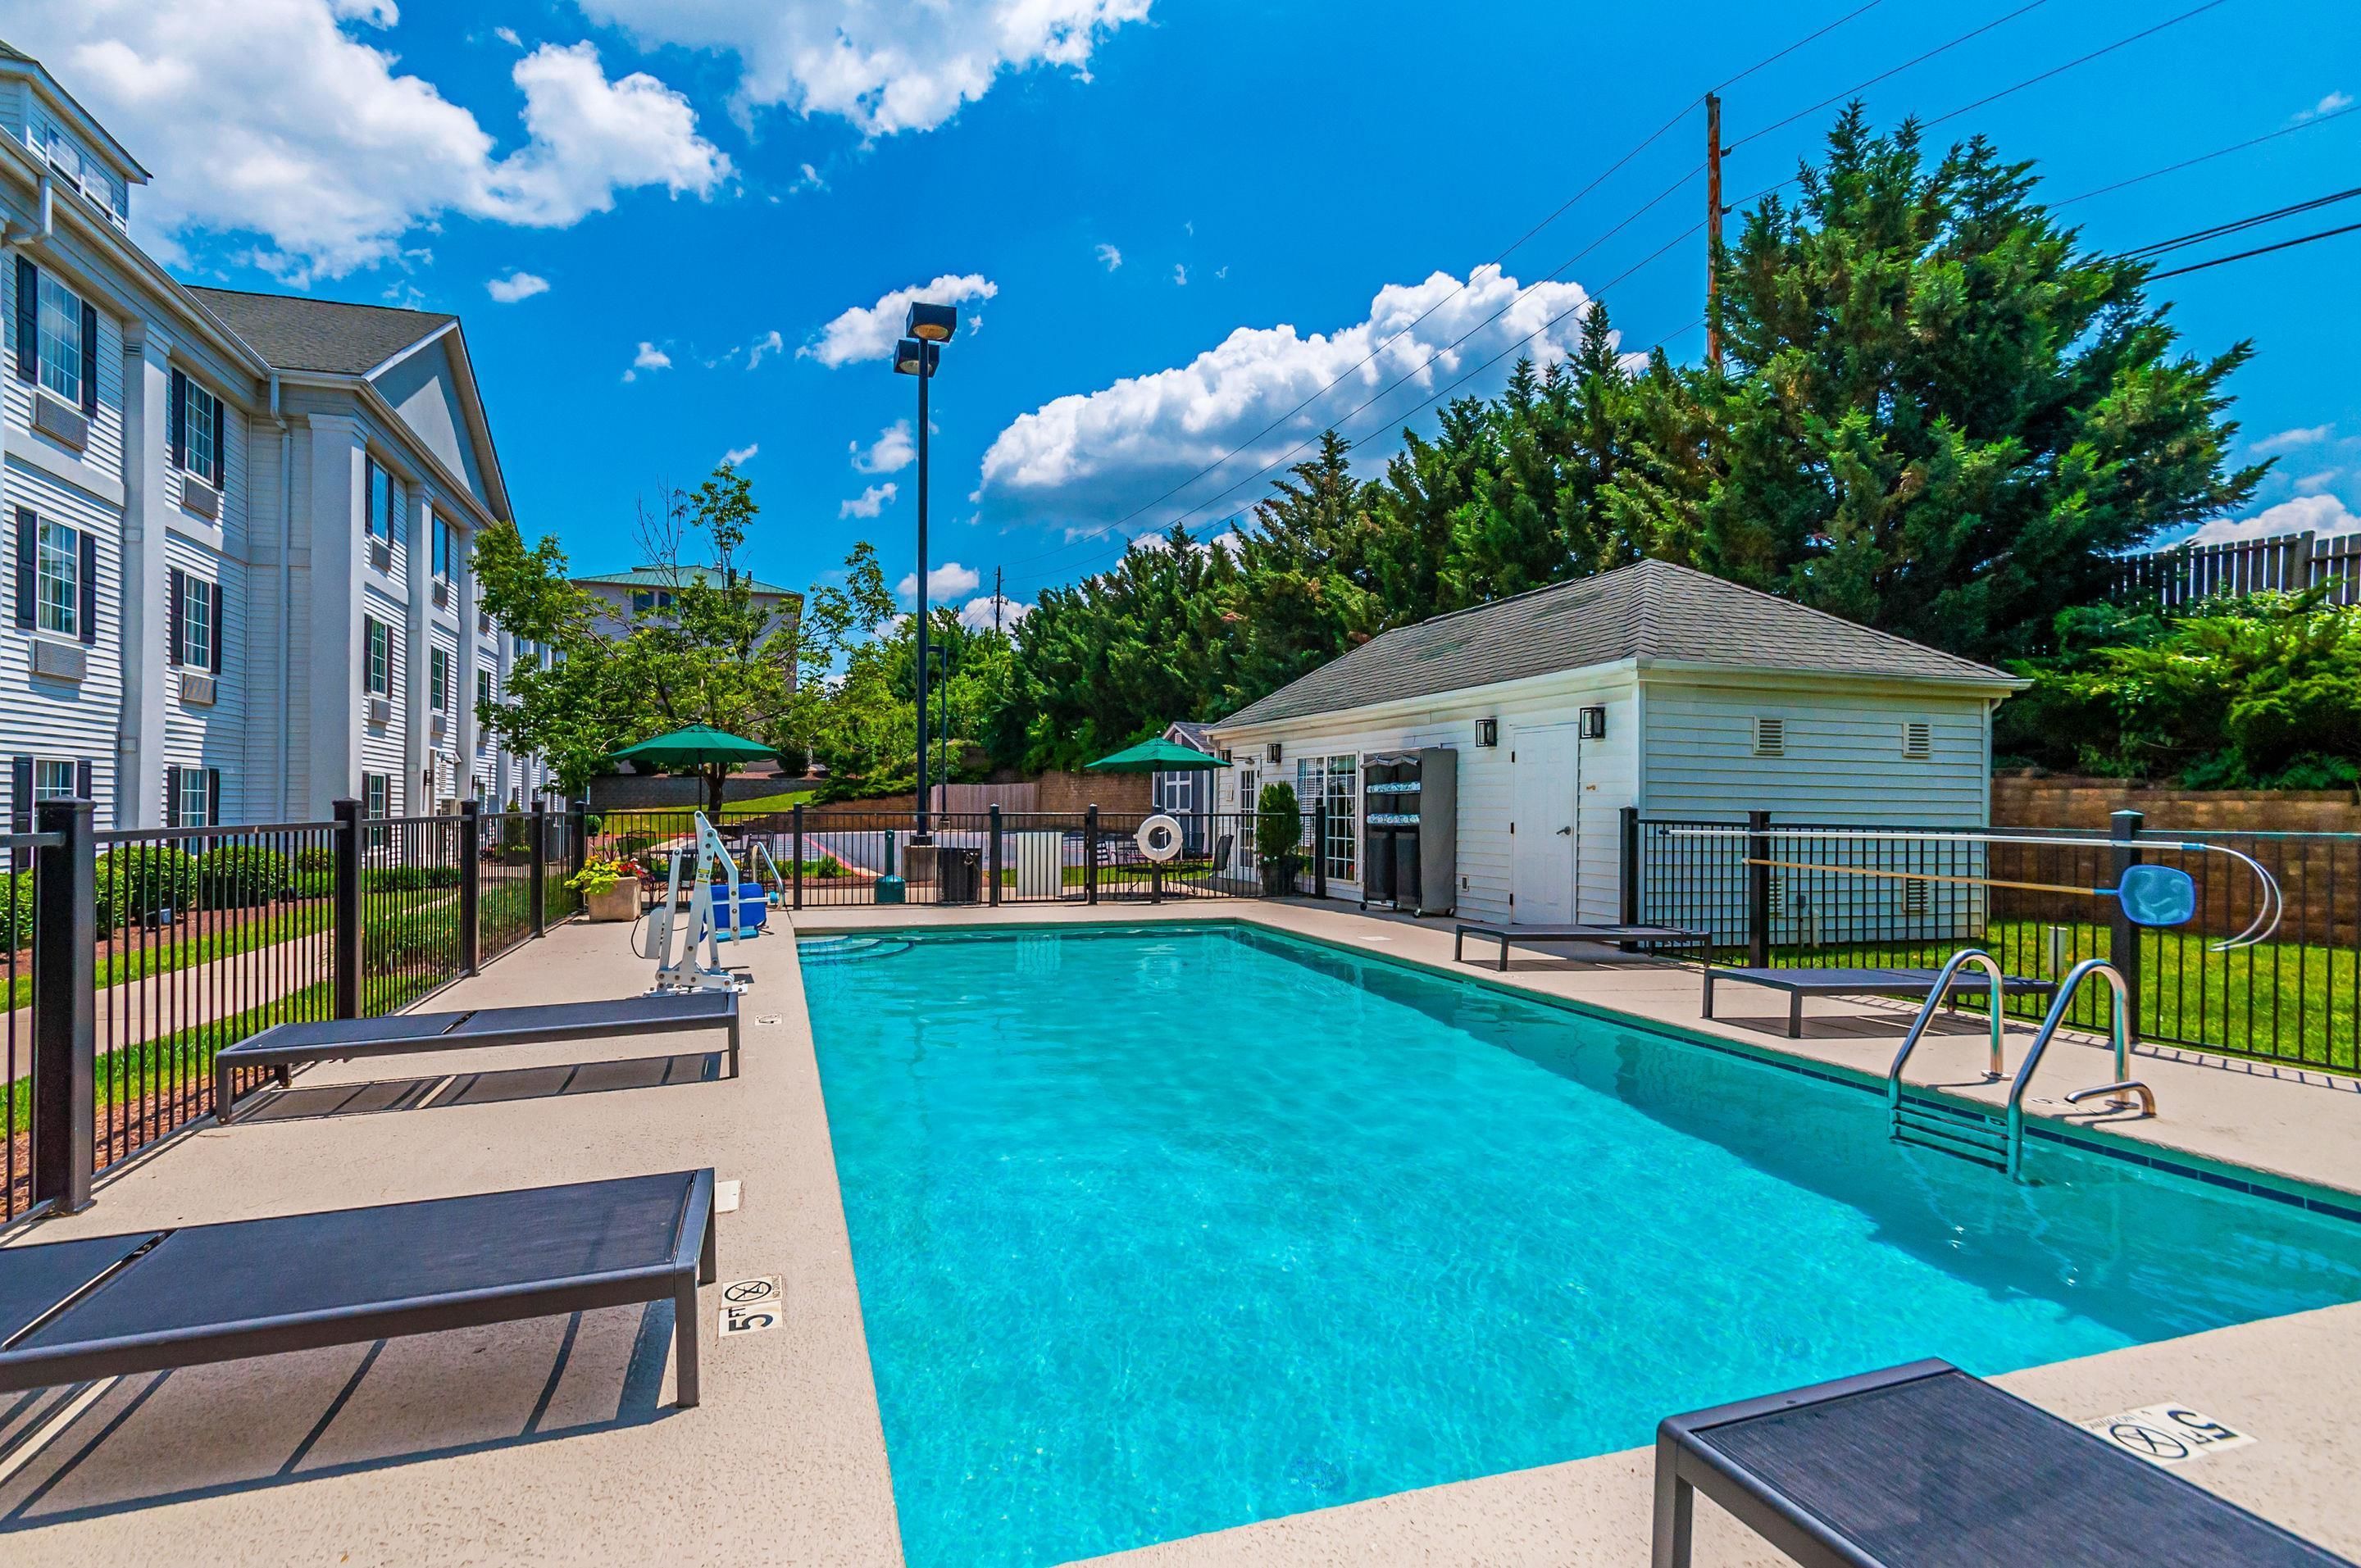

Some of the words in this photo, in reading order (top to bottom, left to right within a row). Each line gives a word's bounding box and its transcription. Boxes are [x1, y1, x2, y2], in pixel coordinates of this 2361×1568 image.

[728, 1307, 746, 1318] FT
[728, 1314, 773, 1331] 5
[2167, 1410, 2239, 1440] 5
